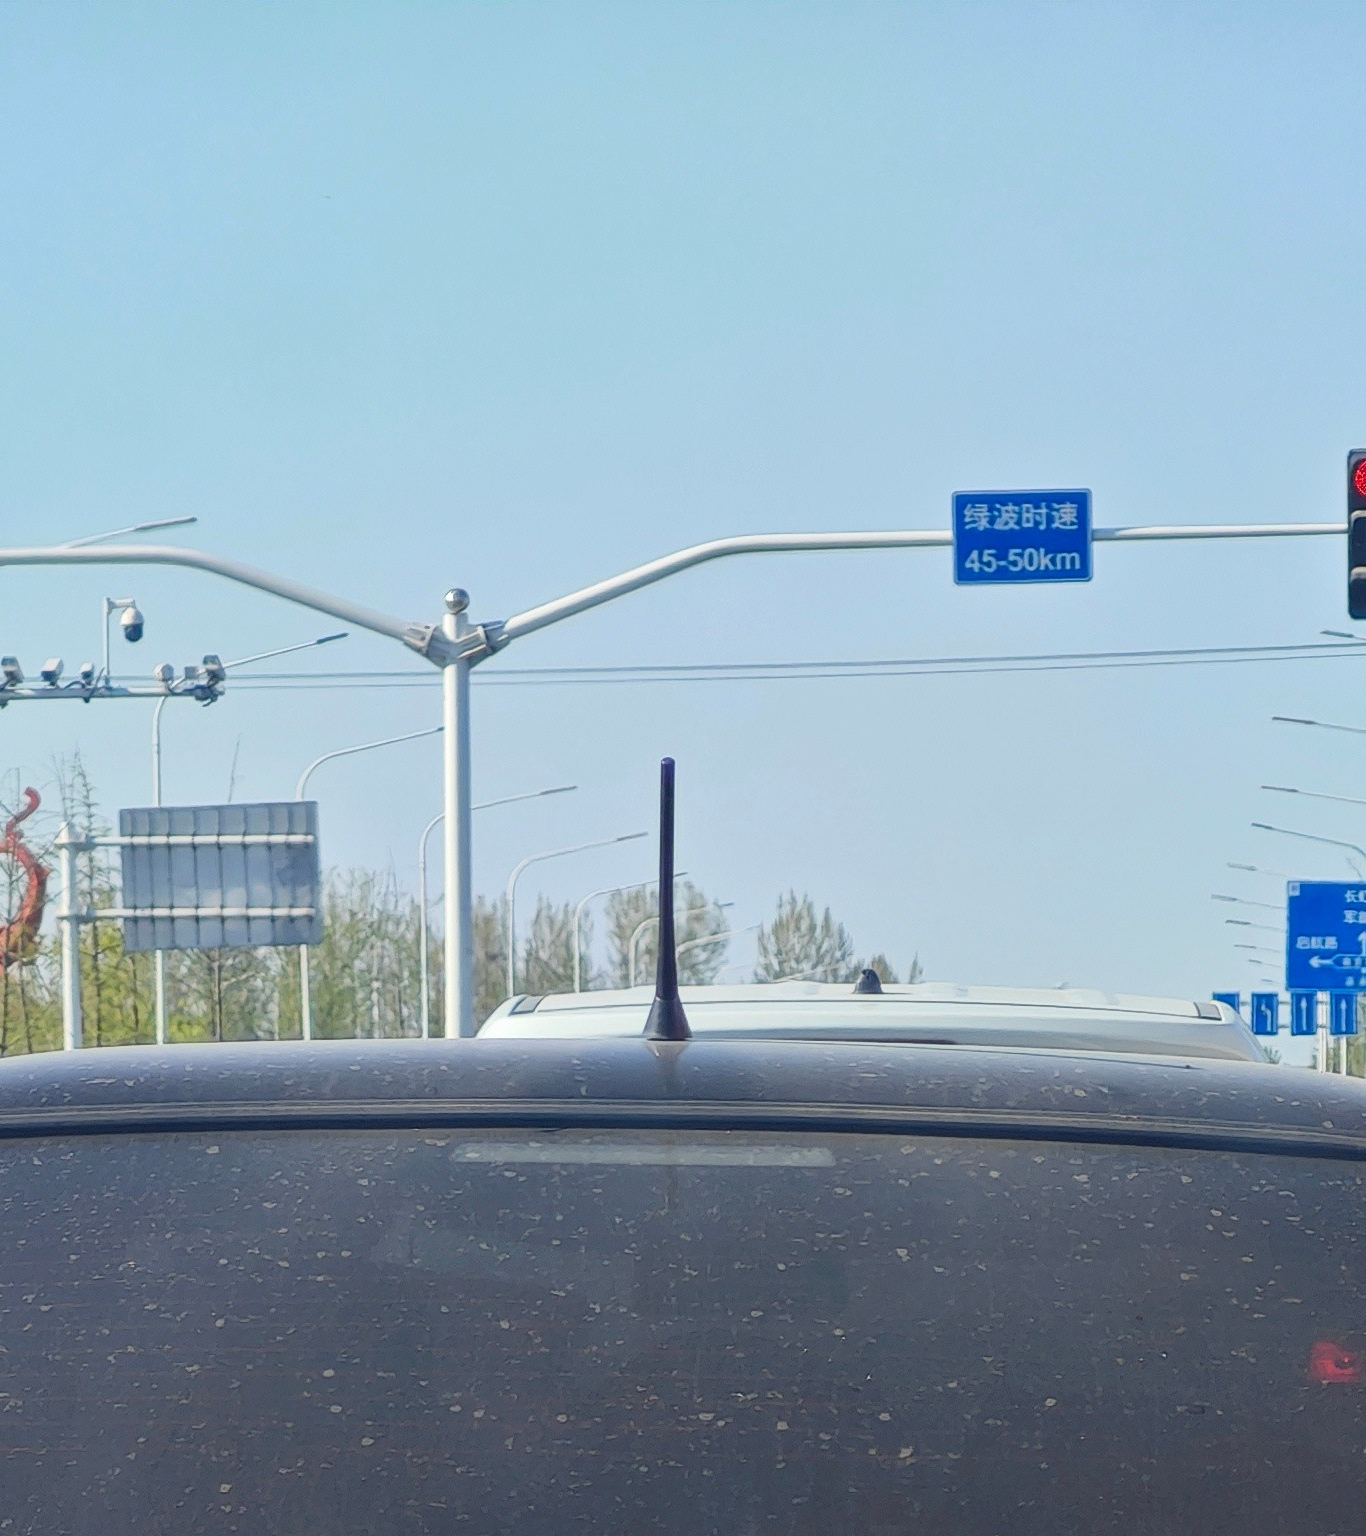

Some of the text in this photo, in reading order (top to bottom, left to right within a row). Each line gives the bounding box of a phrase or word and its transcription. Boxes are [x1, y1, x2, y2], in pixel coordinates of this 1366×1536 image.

[963, 502, 1079, 531] 绿波时速
[964, 547, 1081, 573] 45-50km
